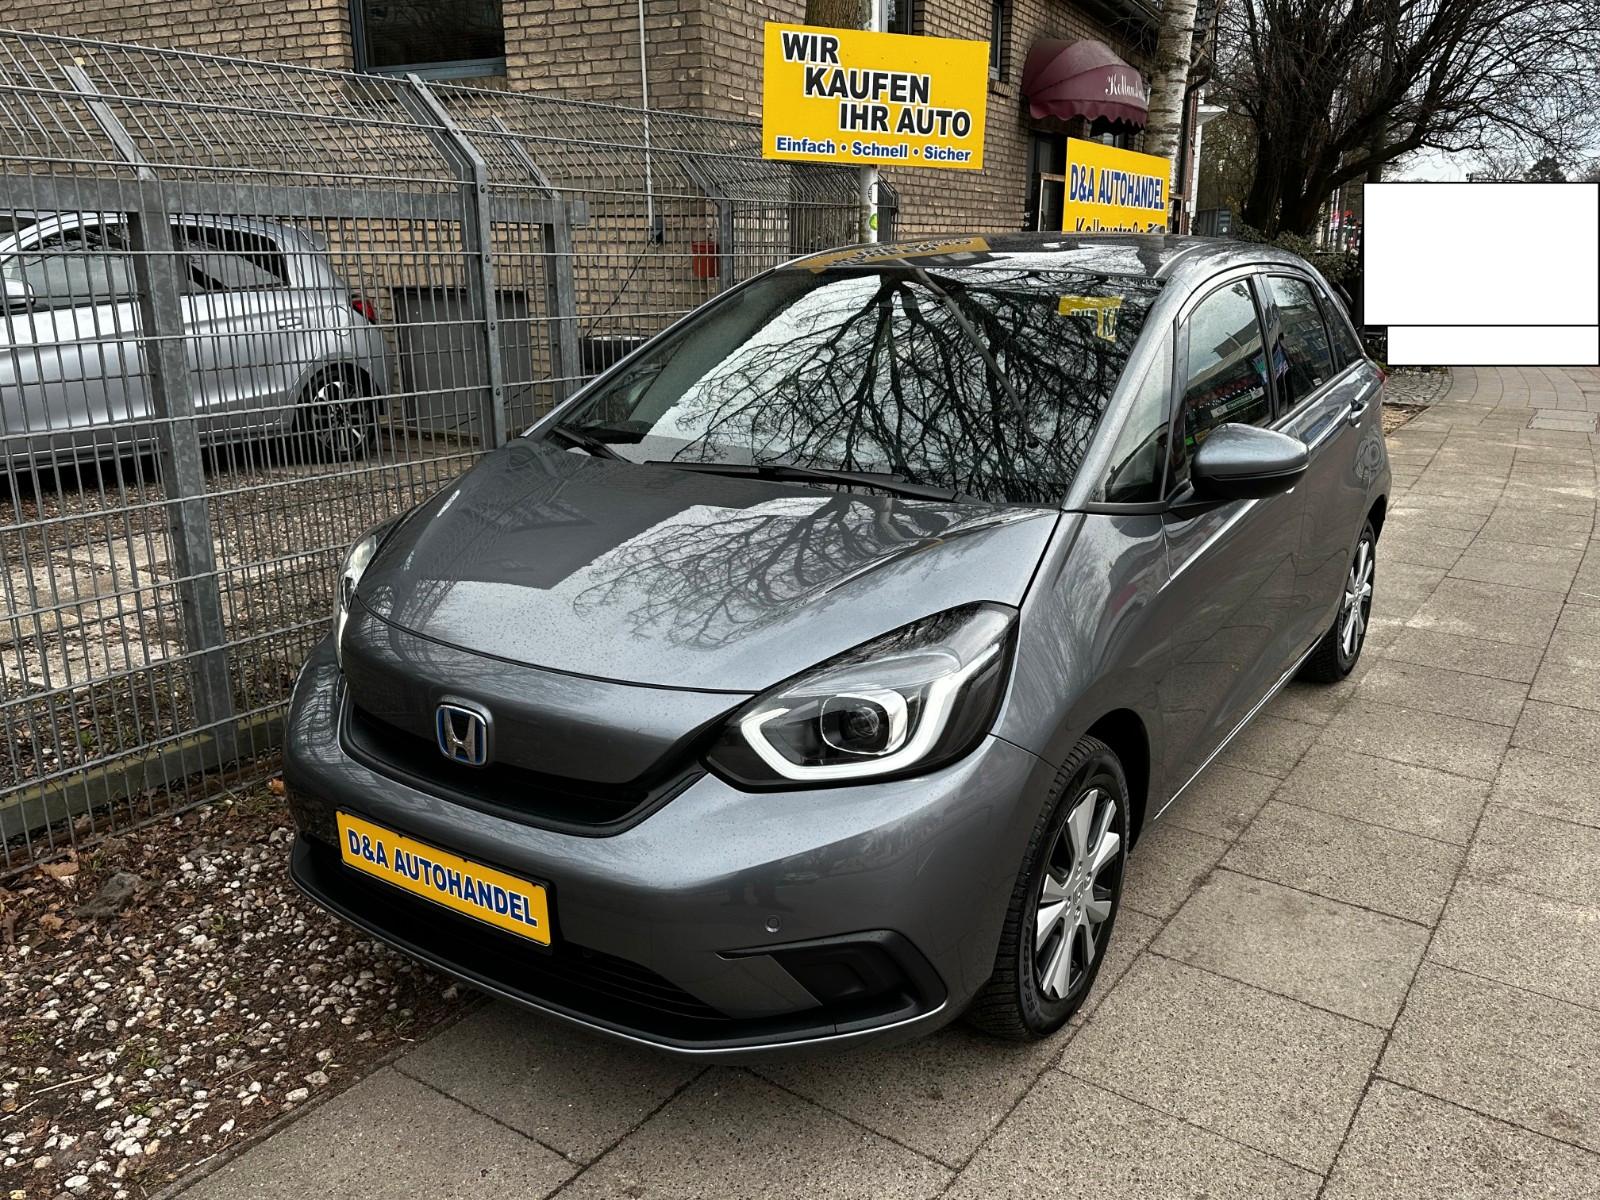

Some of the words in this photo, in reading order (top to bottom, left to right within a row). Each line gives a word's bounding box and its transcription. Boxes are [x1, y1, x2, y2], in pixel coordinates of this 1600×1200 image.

[782, 31, 840, 64] WIR
[804, 66, 930, 104] KAUFEN
[839, 102, 889, 132] IHR
[896, 107, 972, 137] AUTO
[776, 136, 835, 154] Einfach
[852, 140, 908, 158] Schnell
[924, 145, 971, 161] Sicher
[1069, 163, 1095, 203] D&A
[1098, 168, 1165, 210] AUTOHANDEL
[346, 828, 390, 869] D&A
[393, 848, 539, 928] AUTOHANDEL
